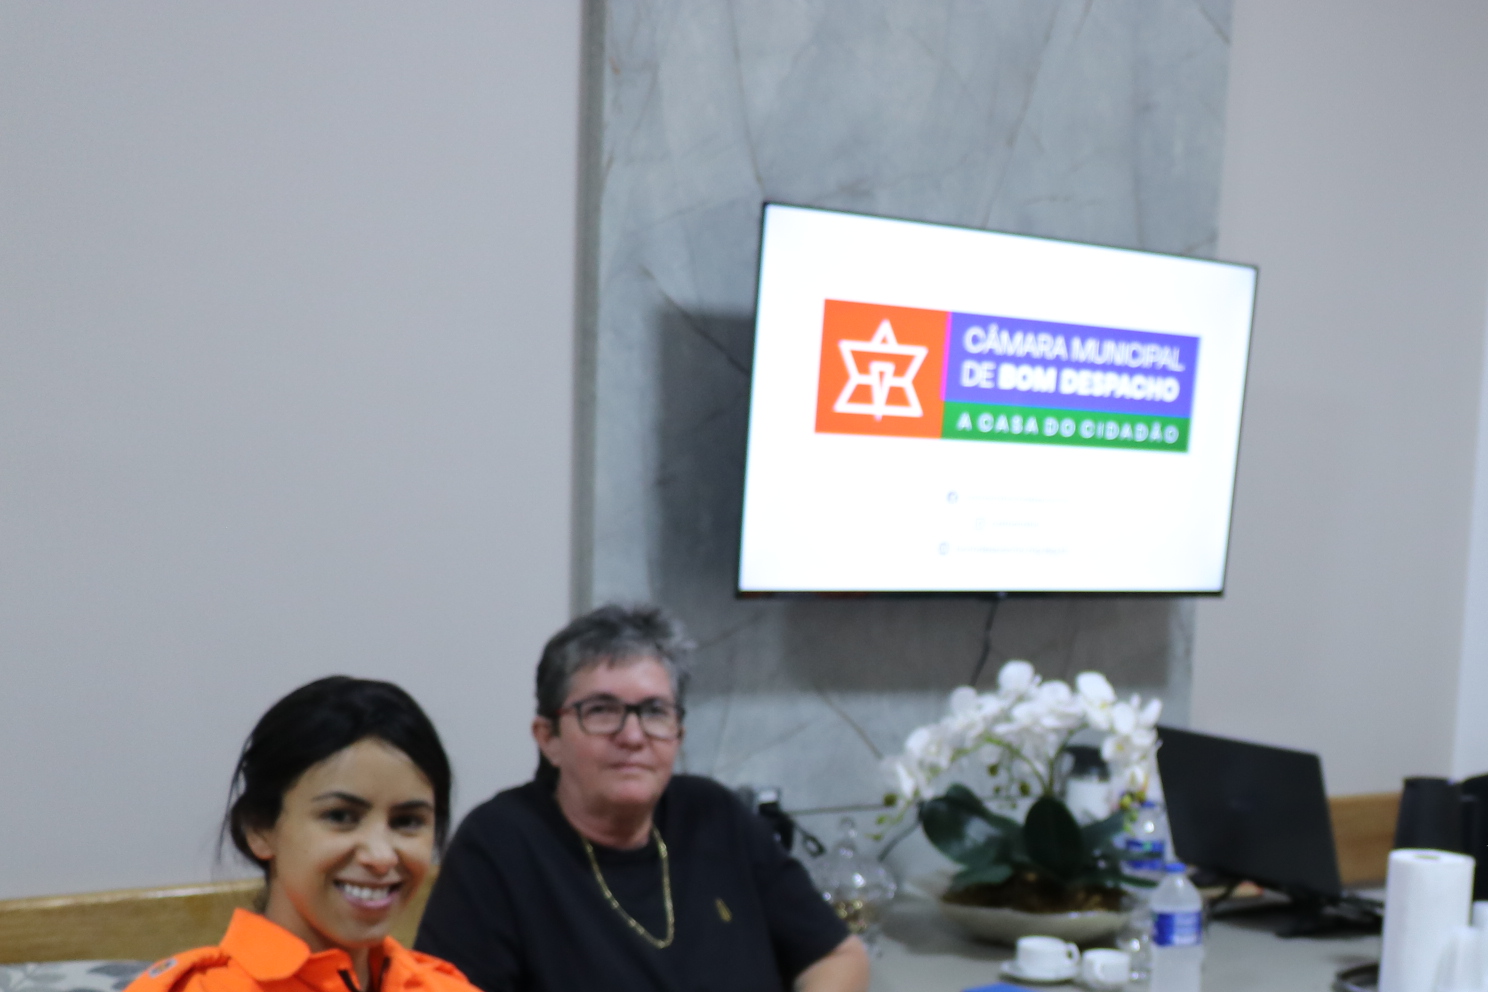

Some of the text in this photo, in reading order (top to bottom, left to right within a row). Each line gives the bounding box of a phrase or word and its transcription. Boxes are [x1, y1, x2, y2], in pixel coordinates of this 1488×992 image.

[963, 323, 1186, 372] CÂMARA MUNICIPAL
[960, 359, 1181, 403] DE BOM DESPACHO
[956, 412, 1180, 444] A CASA DO CIDADÃO
